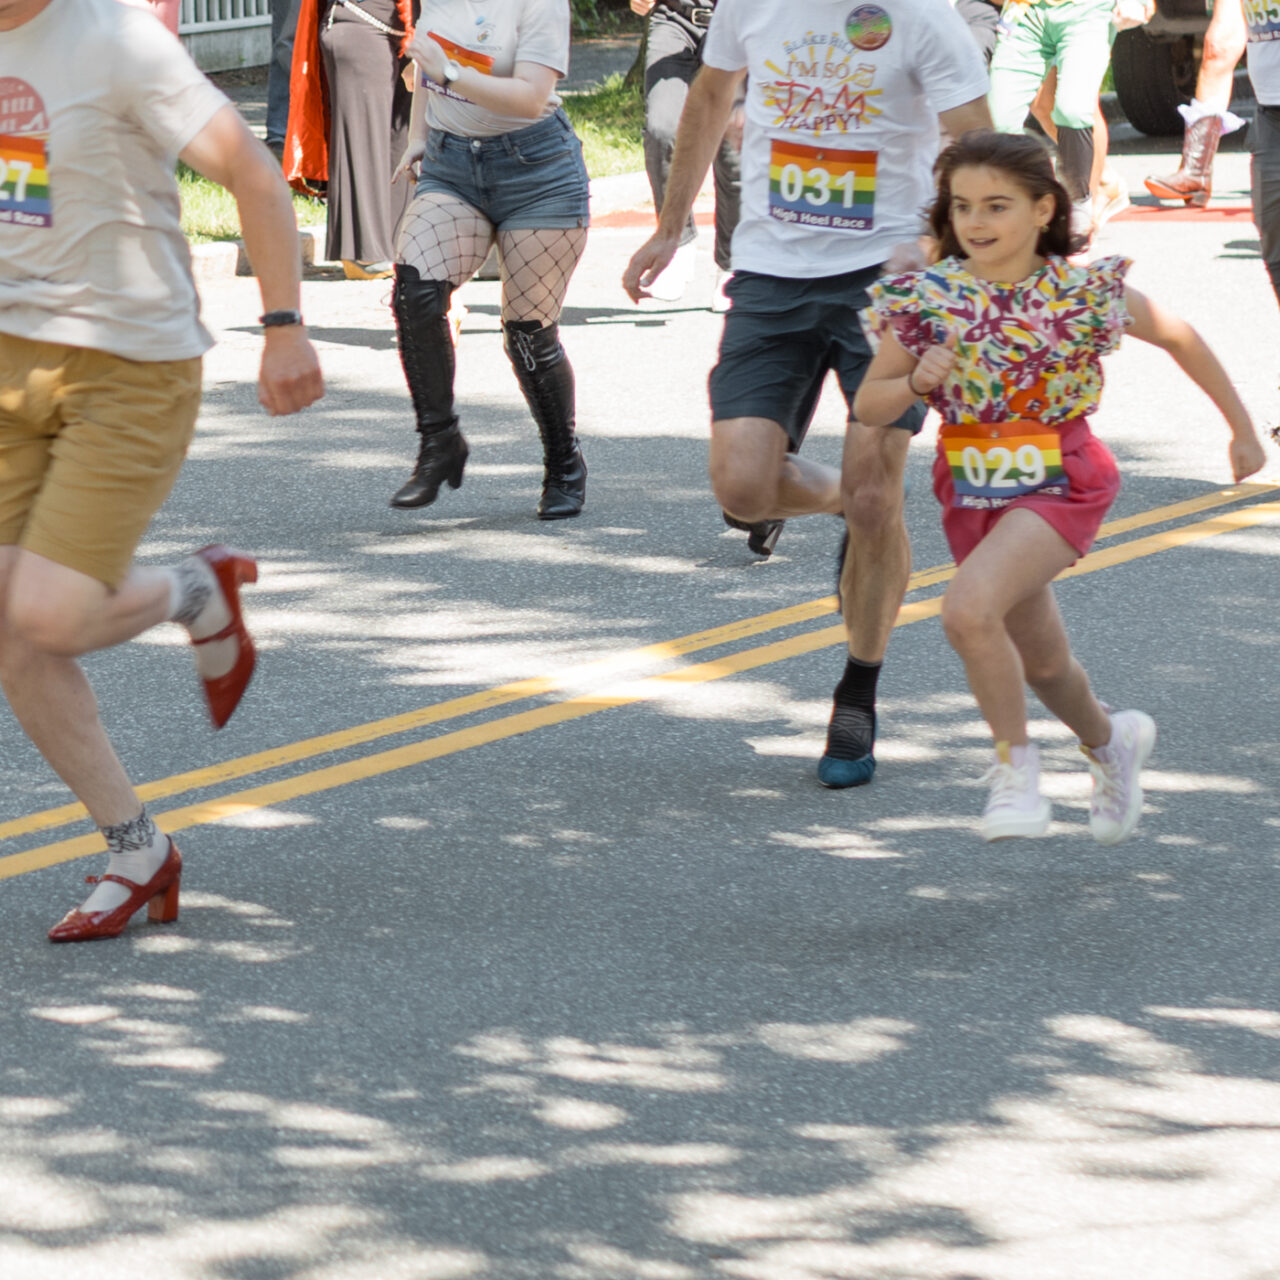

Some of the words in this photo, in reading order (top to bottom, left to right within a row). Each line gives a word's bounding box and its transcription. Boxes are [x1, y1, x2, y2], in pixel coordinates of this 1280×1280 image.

[822, 61, 850, 80] SO
[780, 163, 856, 209] 031
[13, 210, 46, 226] Race
[772, 206, 798, 222] High
[800, 211, 830, 226] Heel
[832, 216, 866, 229] Race
[962, 444, 1046, 488] 029
[961, 495, 990, 510] High
